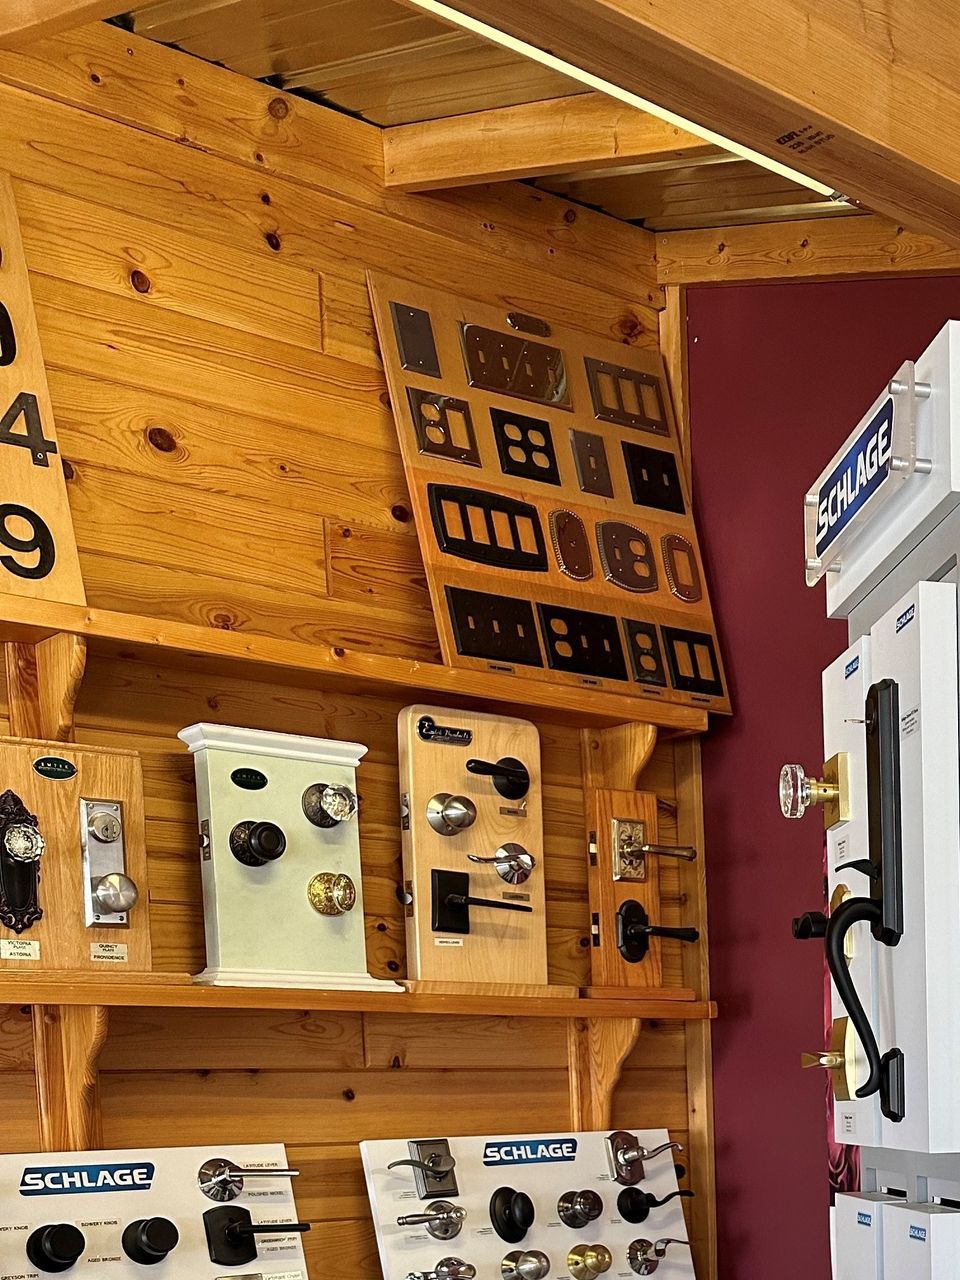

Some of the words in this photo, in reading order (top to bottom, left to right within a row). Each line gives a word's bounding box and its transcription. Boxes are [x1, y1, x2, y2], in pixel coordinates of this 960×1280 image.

[0, 392, 57, 467] 4
[816, 419, 892, 545] SCHLAGE
[0, 503, 55, 579] 9
[19, 1168, 153, 1190] SCHLAGE
[483, 1143, 576, 1162] SCHLAGE
